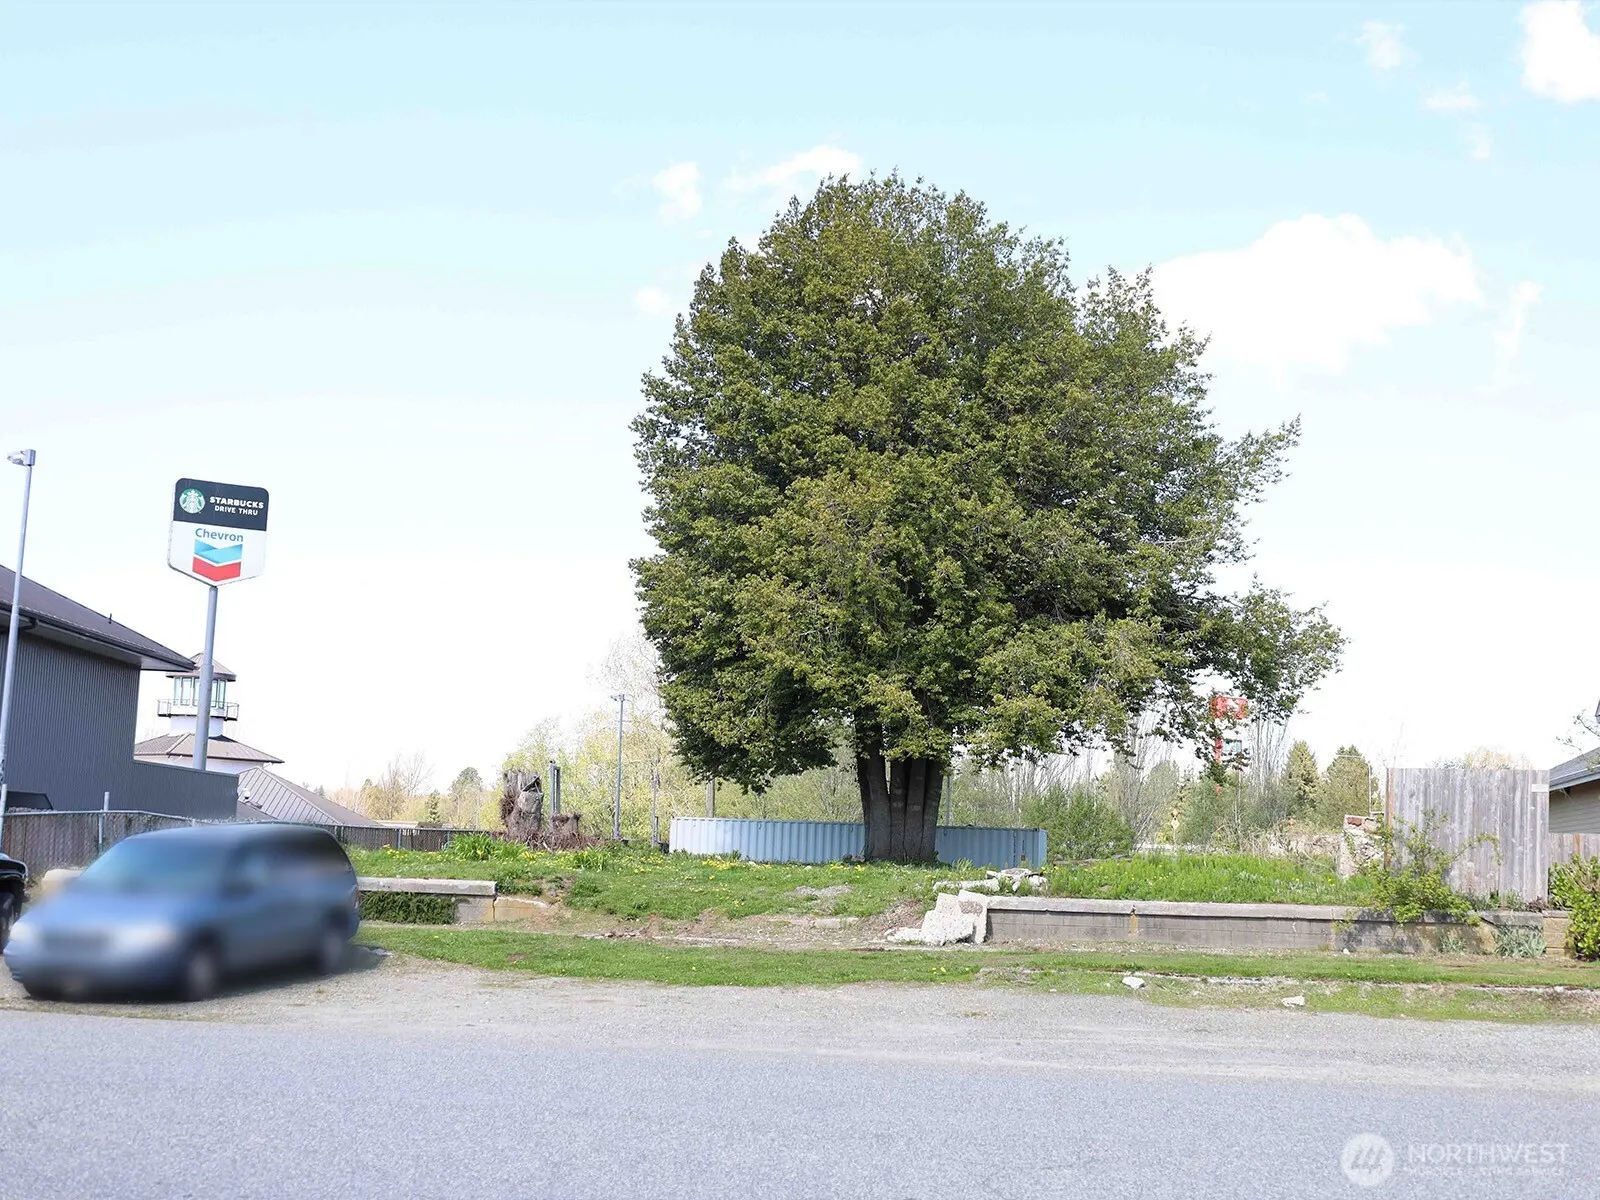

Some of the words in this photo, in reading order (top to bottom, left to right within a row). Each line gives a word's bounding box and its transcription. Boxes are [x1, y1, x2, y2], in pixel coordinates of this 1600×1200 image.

[209, 496, 264, 509] STARBUCKS
[214, 505, 236, 514] DRIVE
[238, 507, 259, 516] THRU
[195, 527, 244, 542] Chevron
